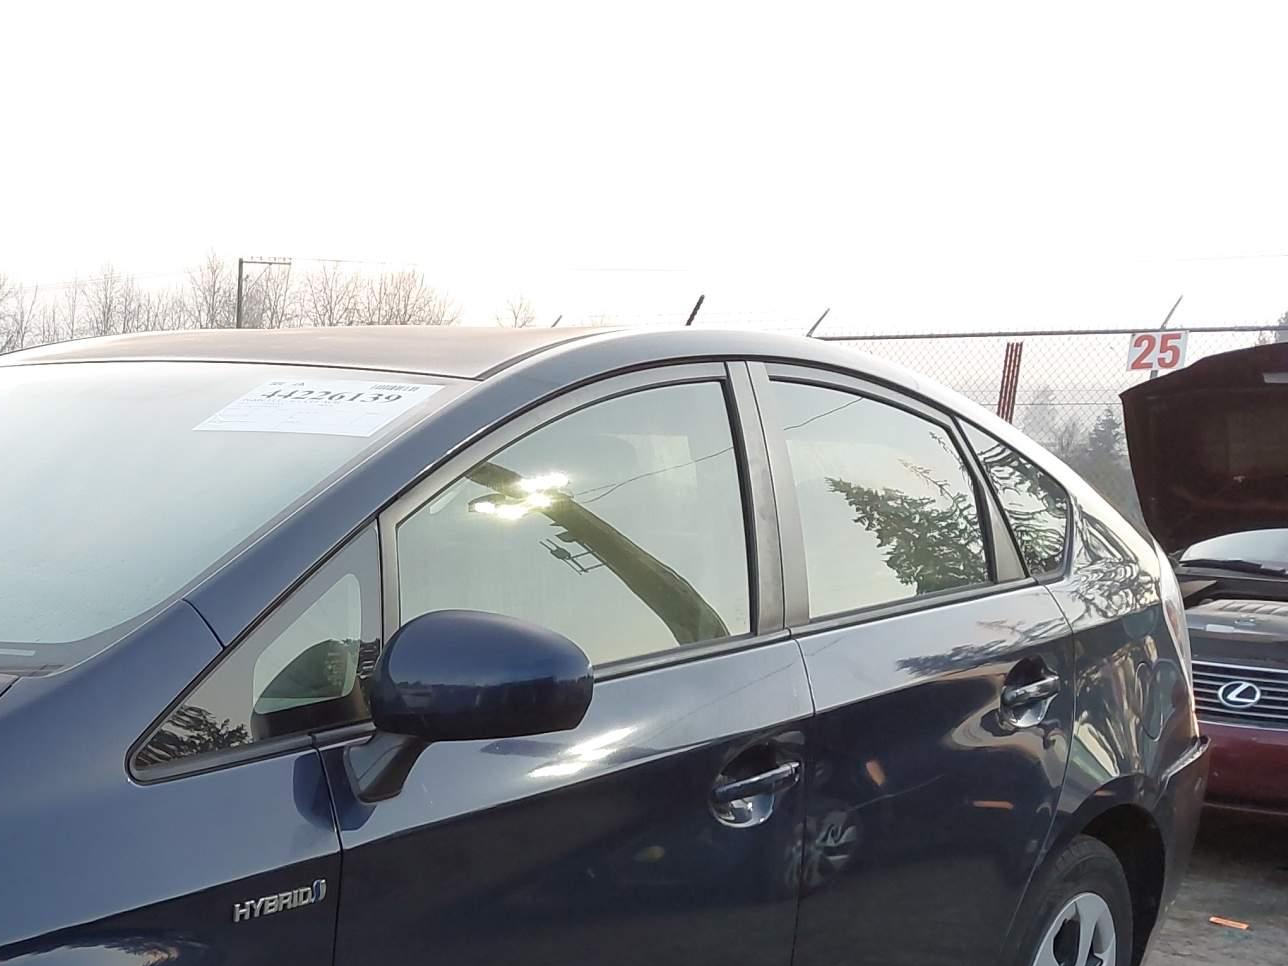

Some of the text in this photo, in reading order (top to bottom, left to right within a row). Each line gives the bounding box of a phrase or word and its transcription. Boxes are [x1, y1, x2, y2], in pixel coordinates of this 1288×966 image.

[1131, 333, 1182, 369] 25
[261, 389, 403, 403] 44226139
[233, 887, 314, 922] HYBRID
